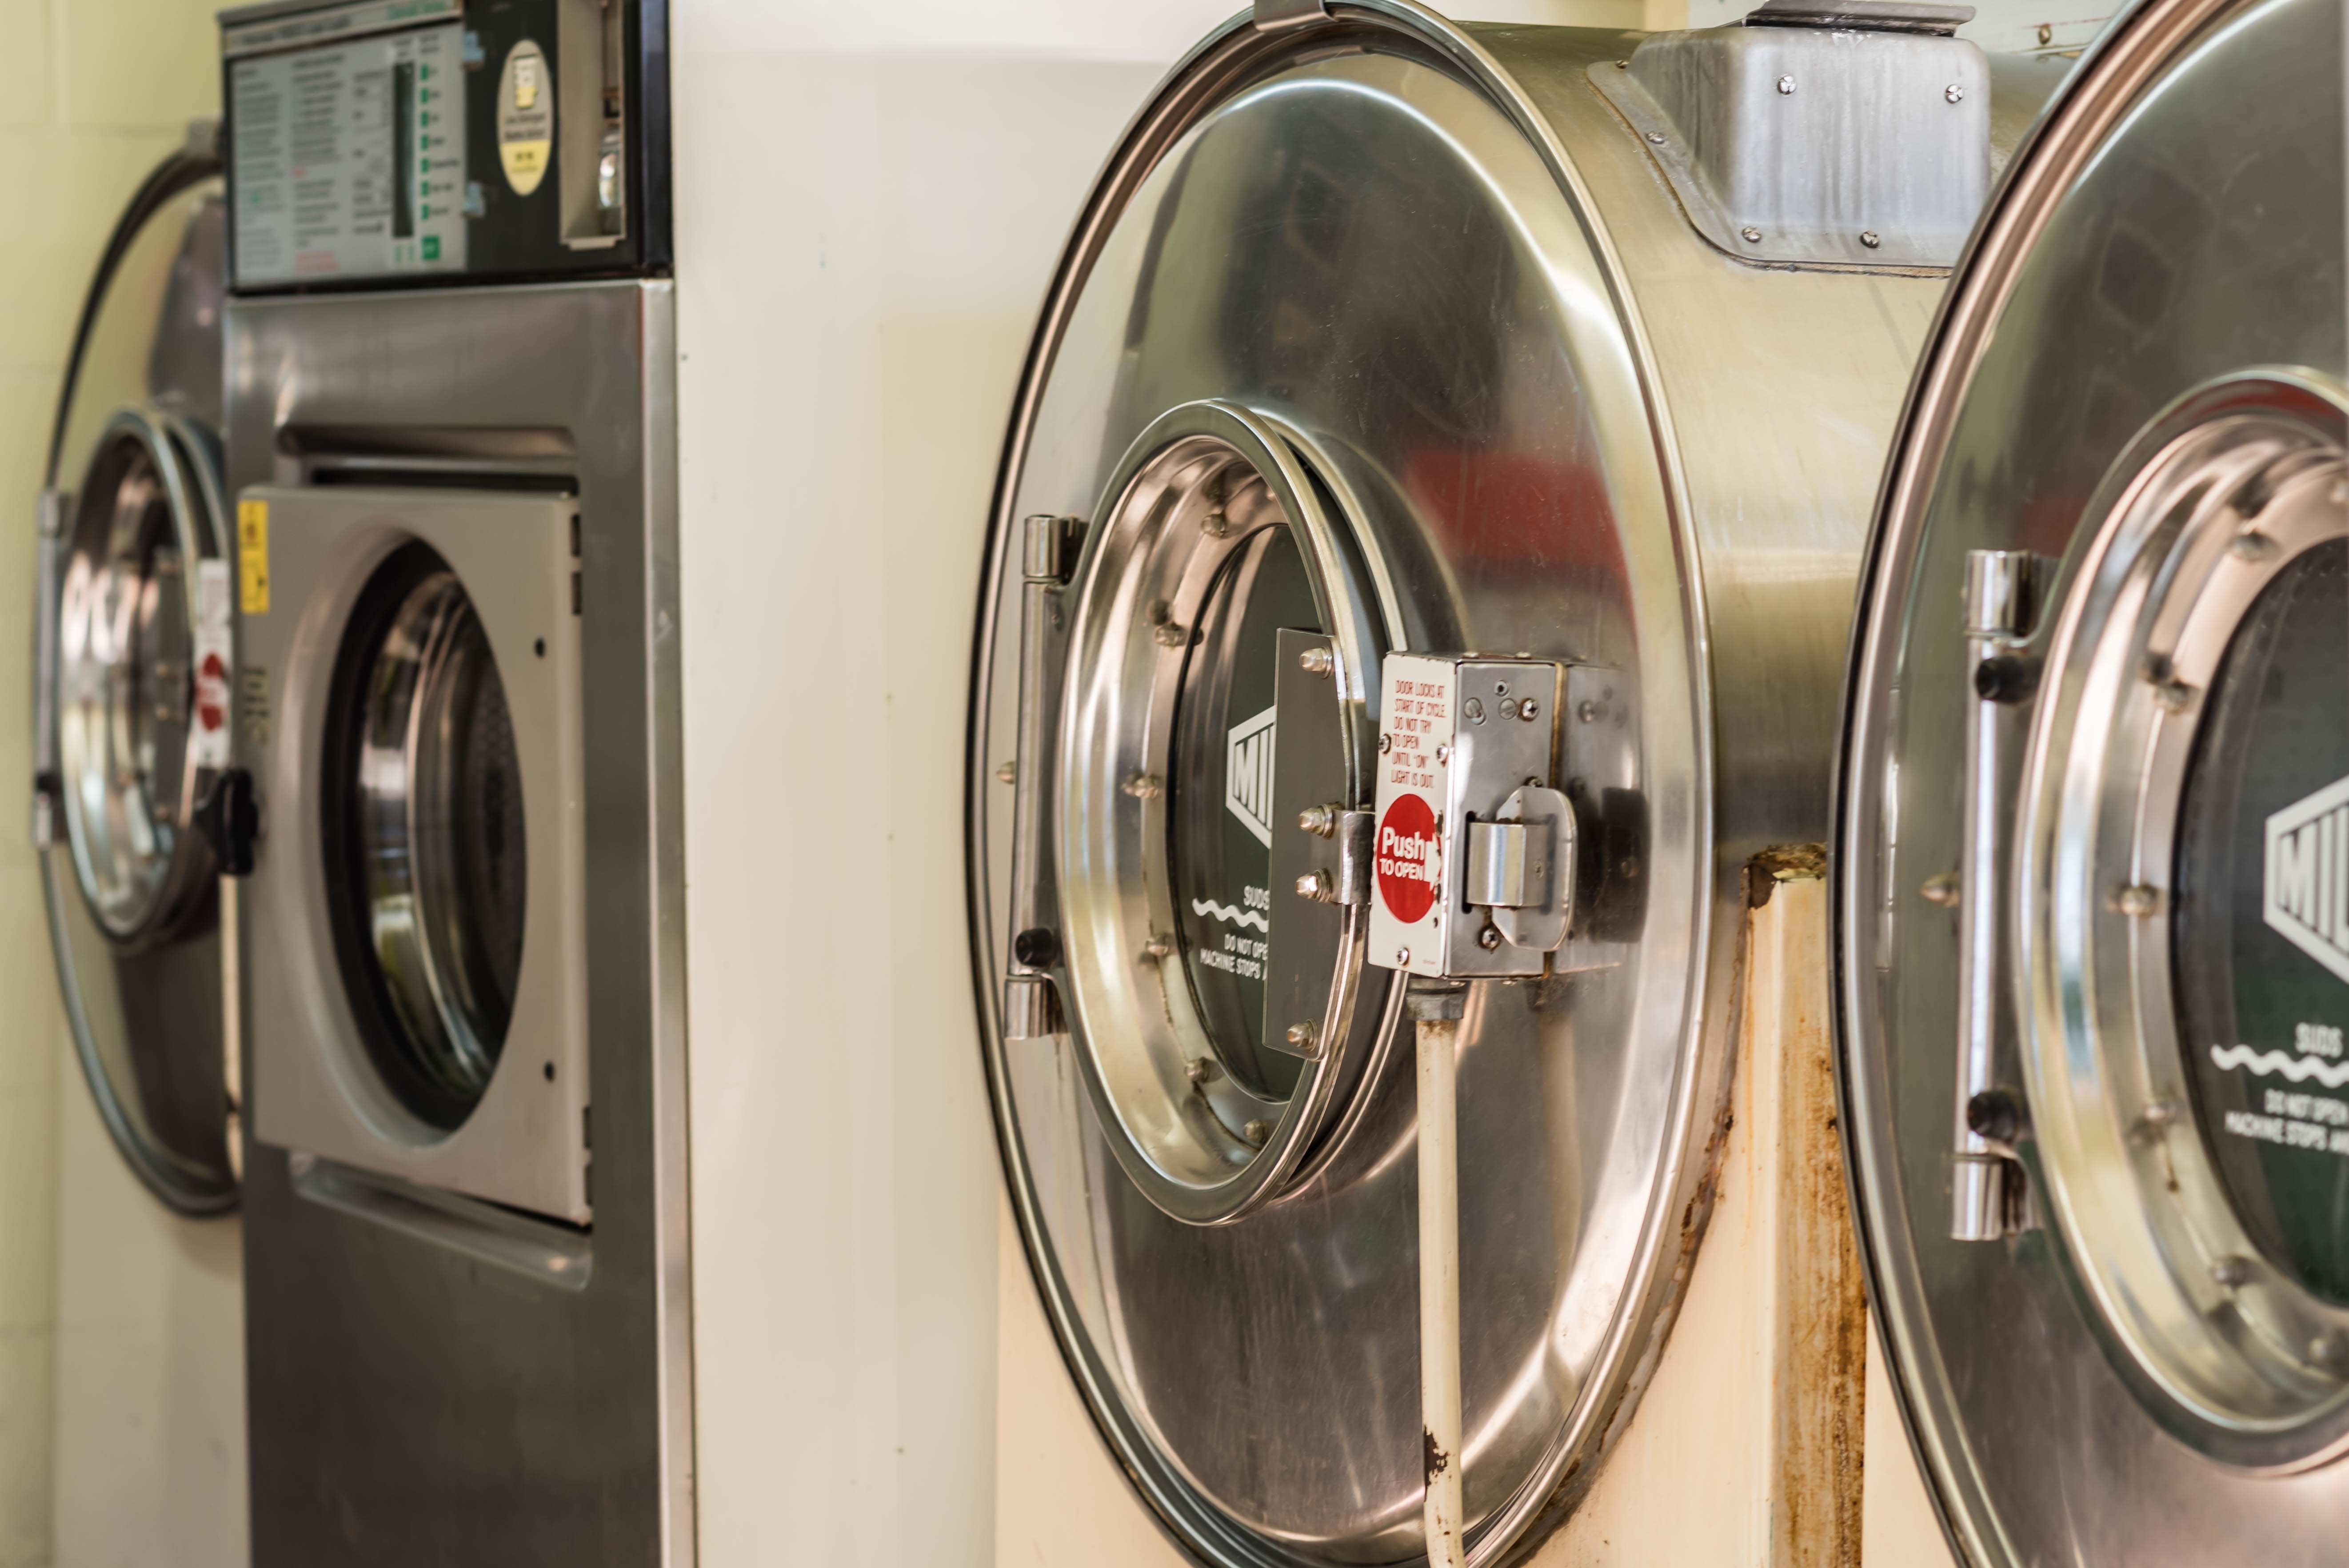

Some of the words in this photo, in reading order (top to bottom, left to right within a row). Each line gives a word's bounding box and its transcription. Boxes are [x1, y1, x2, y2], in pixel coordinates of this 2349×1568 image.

[1395, 680, 1414, 694] DOOR
[1416, 682, 1435, 698] LOCKS
[1437, 686, 1444, 698] AT
[1394, 699, 1414, 713] START
[1416, 702, 1424, 714] OF
[1394, 716, 1403, 730] DO
[1406, 718, 1418, 732] NOT
[1420, 720, 1432, 734] TRY
[1393, 734, 1400, 747] TO
[1402, 735, 1419, 749] OPEN
[1392, 752, 1410, 766] UNTIL
[1391, 770, 1410, 785] LIGHT
[1411, 773, 1418, 786] IS
[1382, 826, 1425, 861] Push
[1379, 858, 1394, 875] TO
[1394, 861, 1424, 881] OPEN
[1243, 885, 1270, 910] SUDS
[1224, 933, 1236, 951] DO
[1237, 937, 1253, 956] NOT
[1252, 941, 1268, 961] OPE
[1200, 948, 1235, 973] MACHINE
[1236, 958, 1261, 979] STOPS
[2295, 1022, 2343, 1058] SUDS
